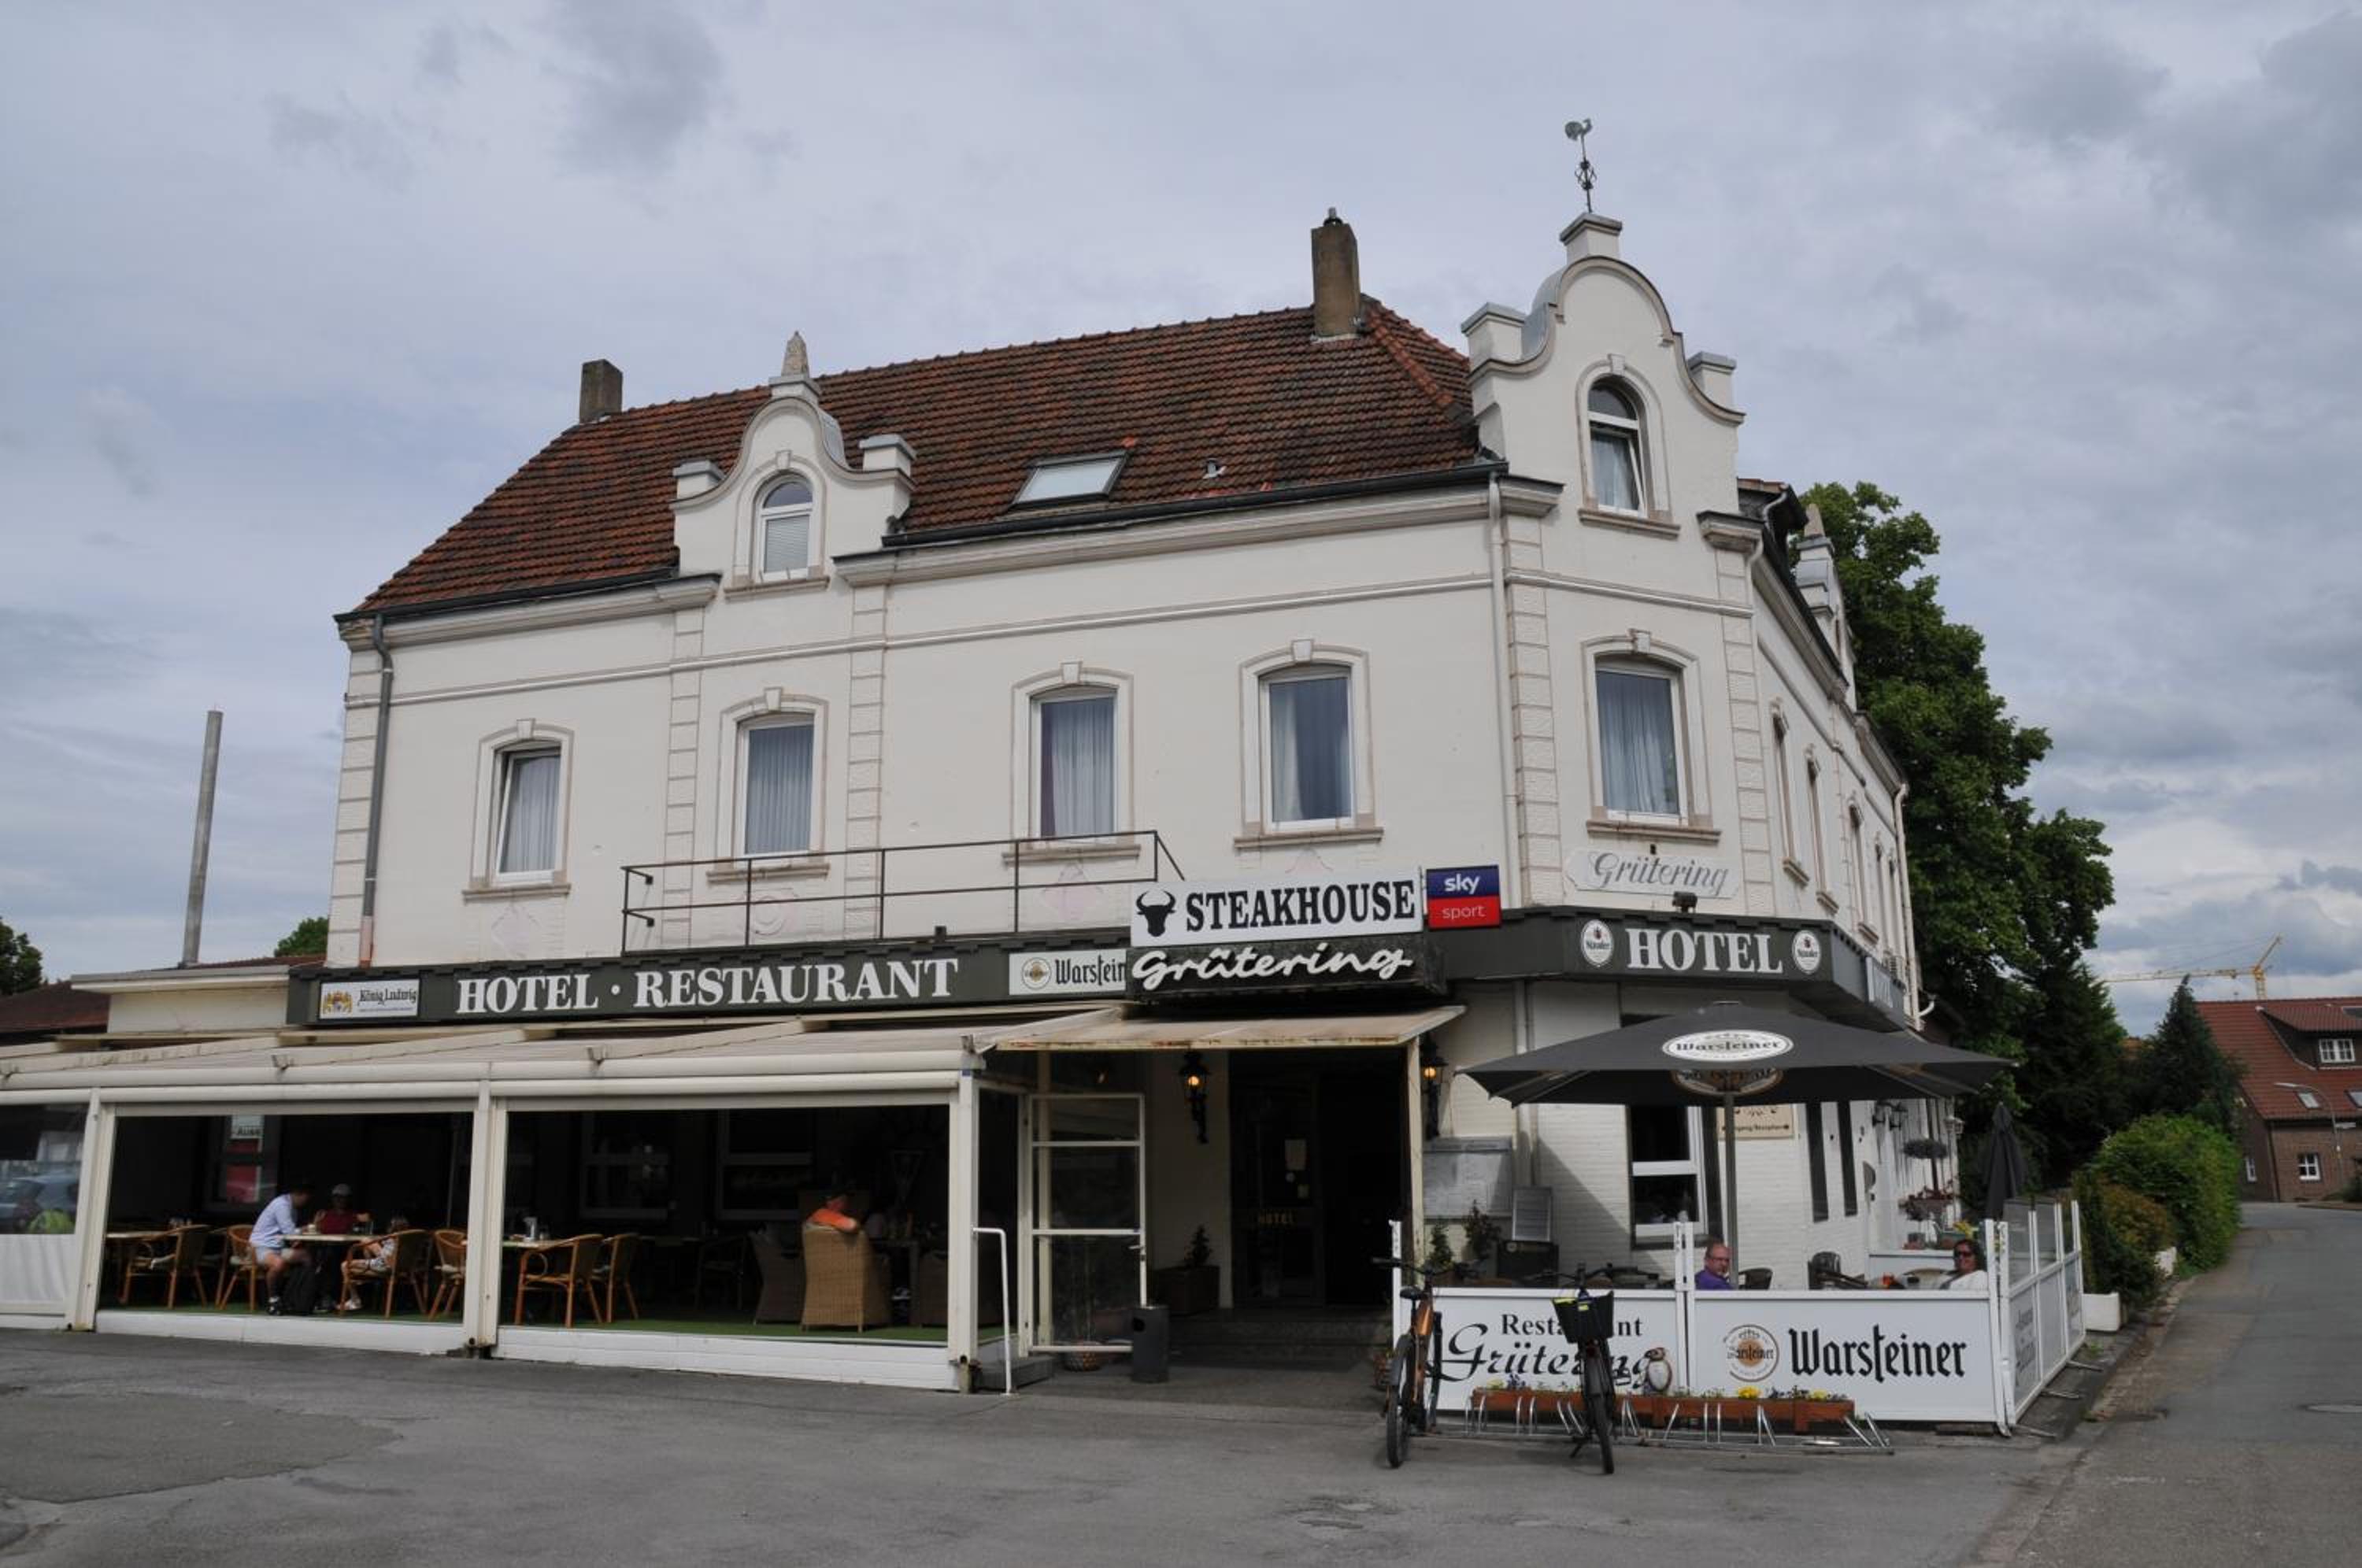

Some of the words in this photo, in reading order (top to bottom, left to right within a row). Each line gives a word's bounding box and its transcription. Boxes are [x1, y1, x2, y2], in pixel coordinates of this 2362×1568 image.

[1444, 873, 1480, 895] sky
[1589, 851, 1729, 897] Grütering
[1186, 879, 1416, 932] STEAKHOUSE
[1442, 904, 1487, 919] sport
[1054, 954, 1127, 986] Warstein
[1131, 942, 1414, 991] Grütering
[1625, 927, 1783, 974] HOTEL
[455, 974, 599, 1015] HOTEL
[632, 958, 959, 1008] RESTAURANT
[1675, 1041, 1782, 1052] Warsteiner
[1501, 1313, 1643, 1337] Restant
[1788, 1323, 1968, 1384] Warsteiner
